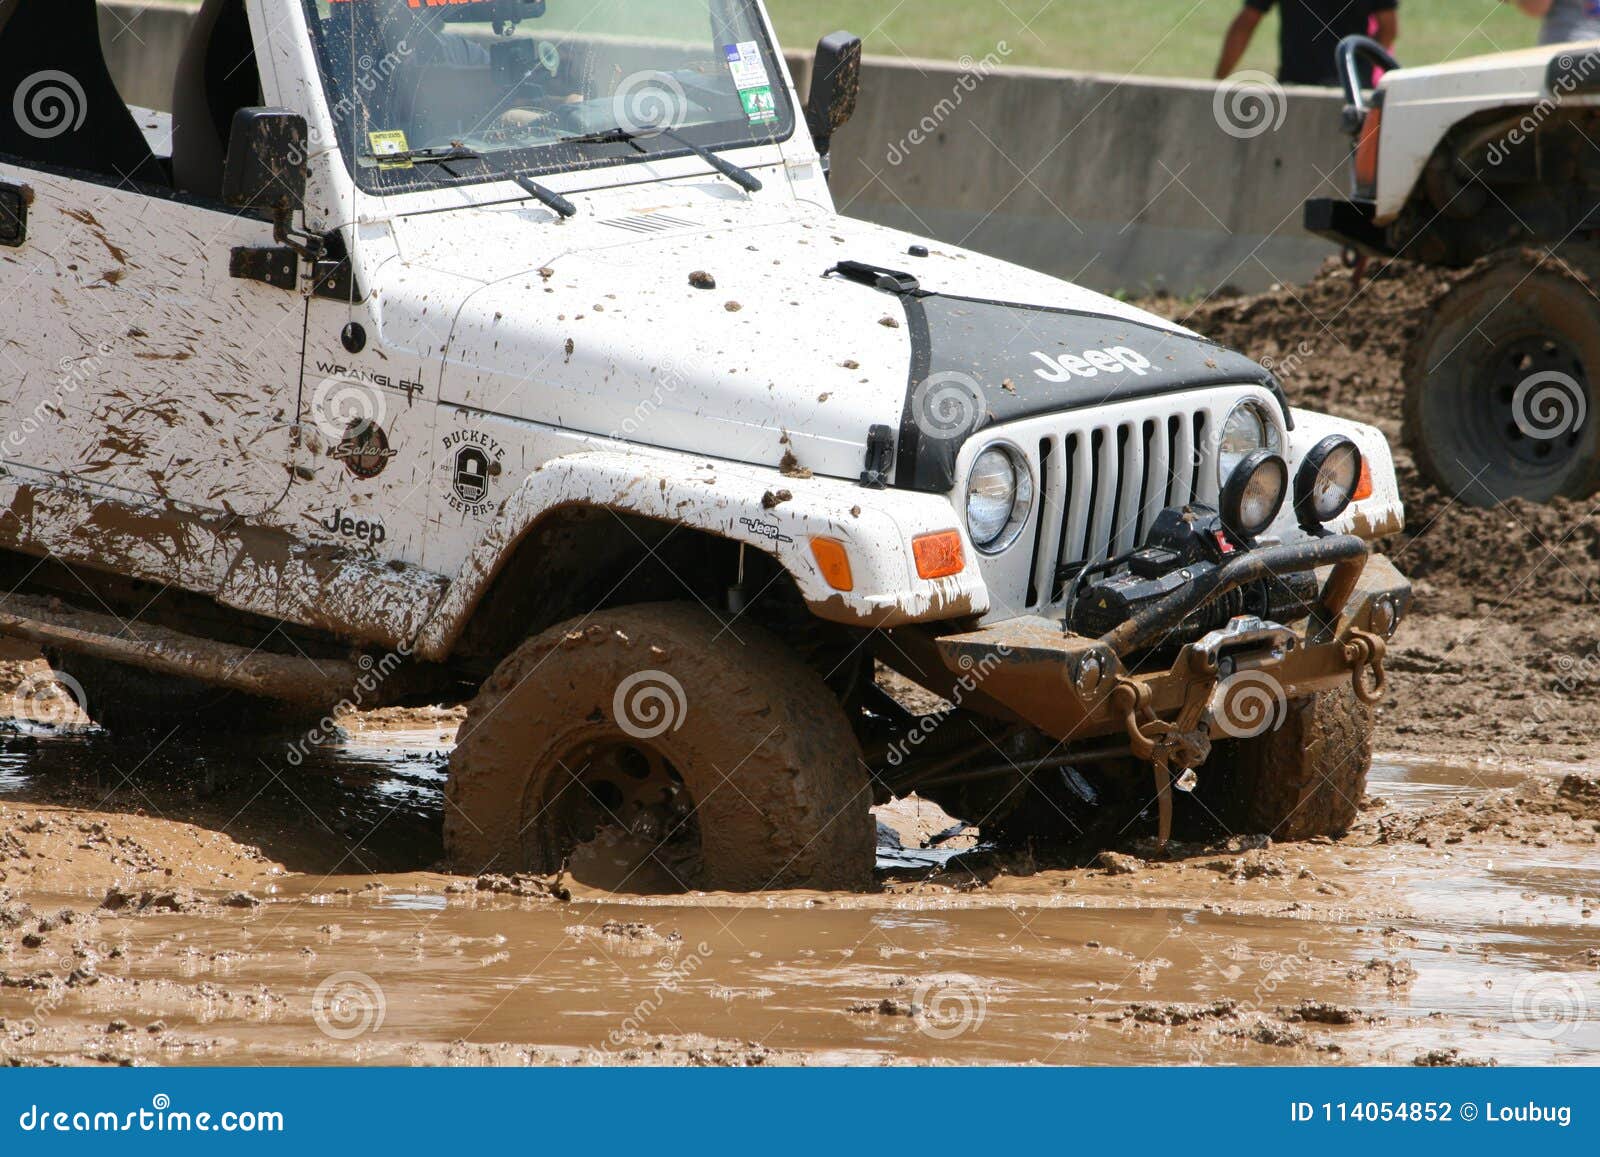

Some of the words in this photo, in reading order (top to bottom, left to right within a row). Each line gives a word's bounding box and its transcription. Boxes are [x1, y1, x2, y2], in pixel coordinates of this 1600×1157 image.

[317, 361, 424, 396] WRANGLER
[1030, 346, 1150, 382] Jeep
[333, 440, 397, 460] Sahara
[443, 430, 505, 461] BUCKEYE
[443, 492, 495, 516] JEEPERS
[322, 508, 385, 546] Jeep
[749, 519, 778, 538] Jeep
